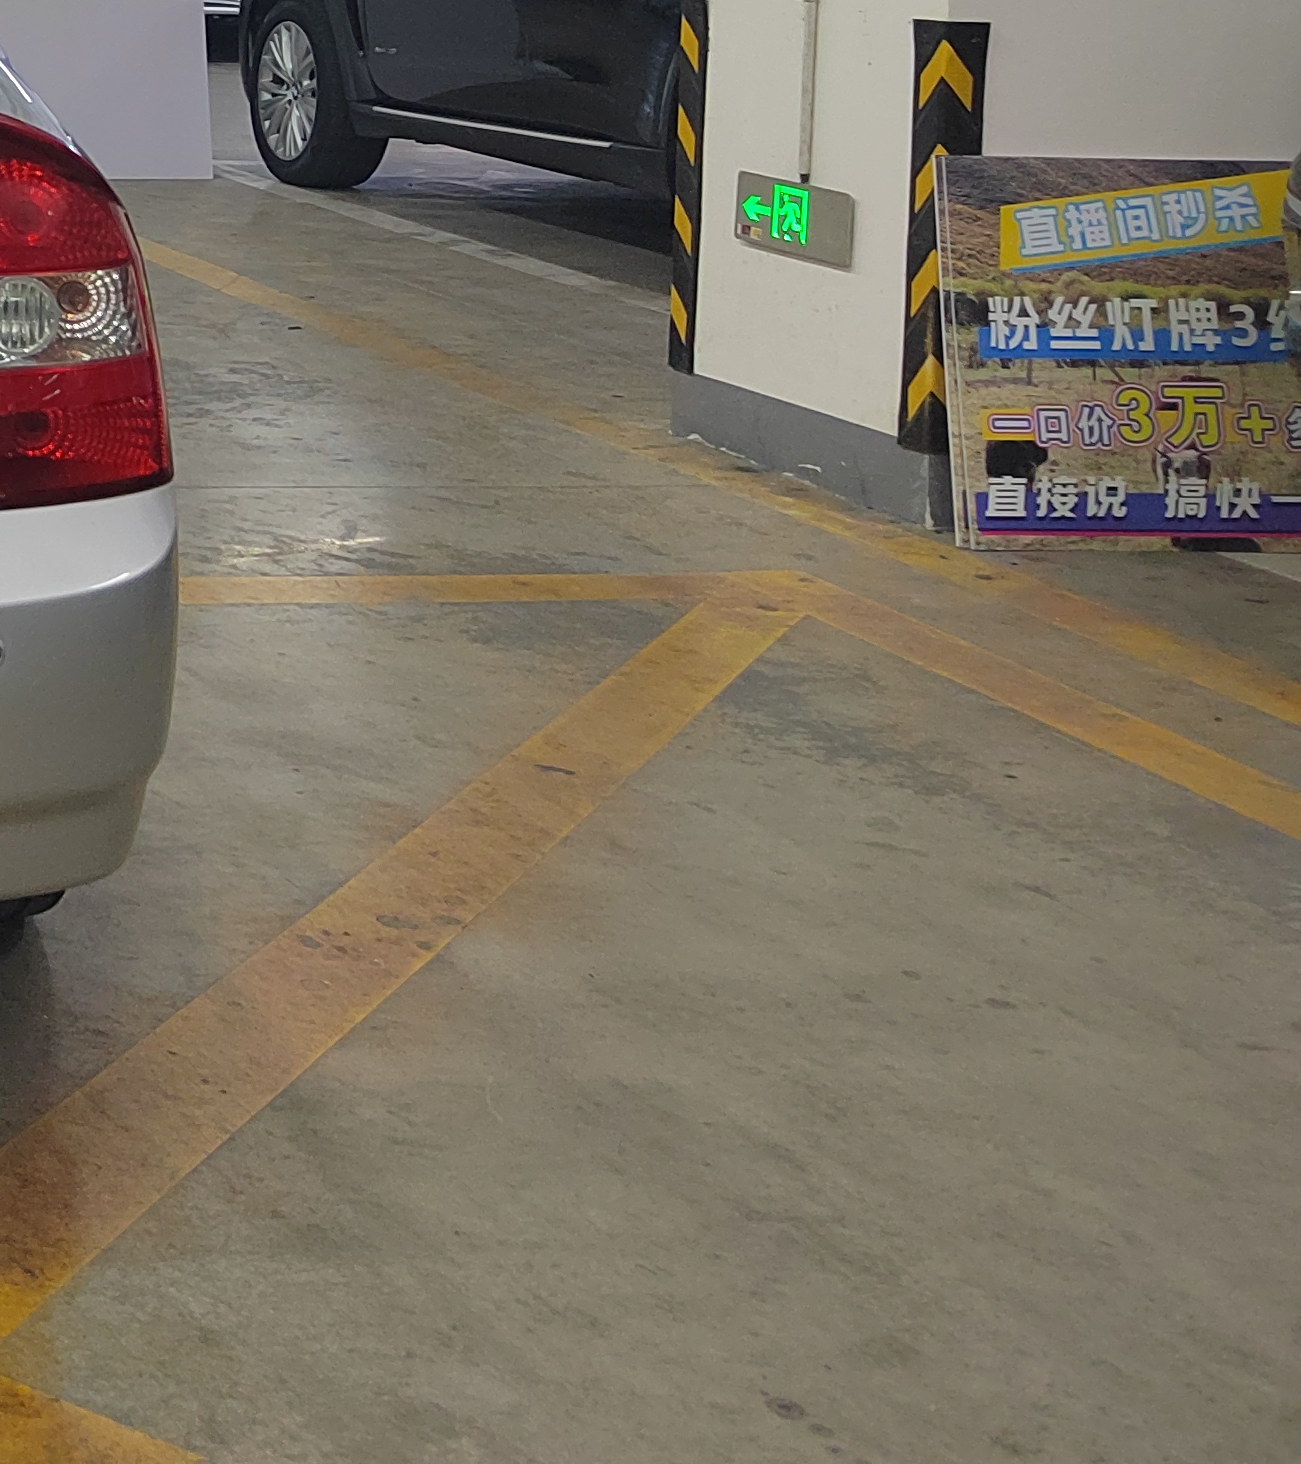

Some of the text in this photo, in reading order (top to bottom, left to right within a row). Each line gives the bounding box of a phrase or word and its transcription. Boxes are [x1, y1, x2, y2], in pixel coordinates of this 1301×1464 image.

[1015, 184, 1261, 258] 直播间秒杀
[985, 476, 1128, 519] 直接说
